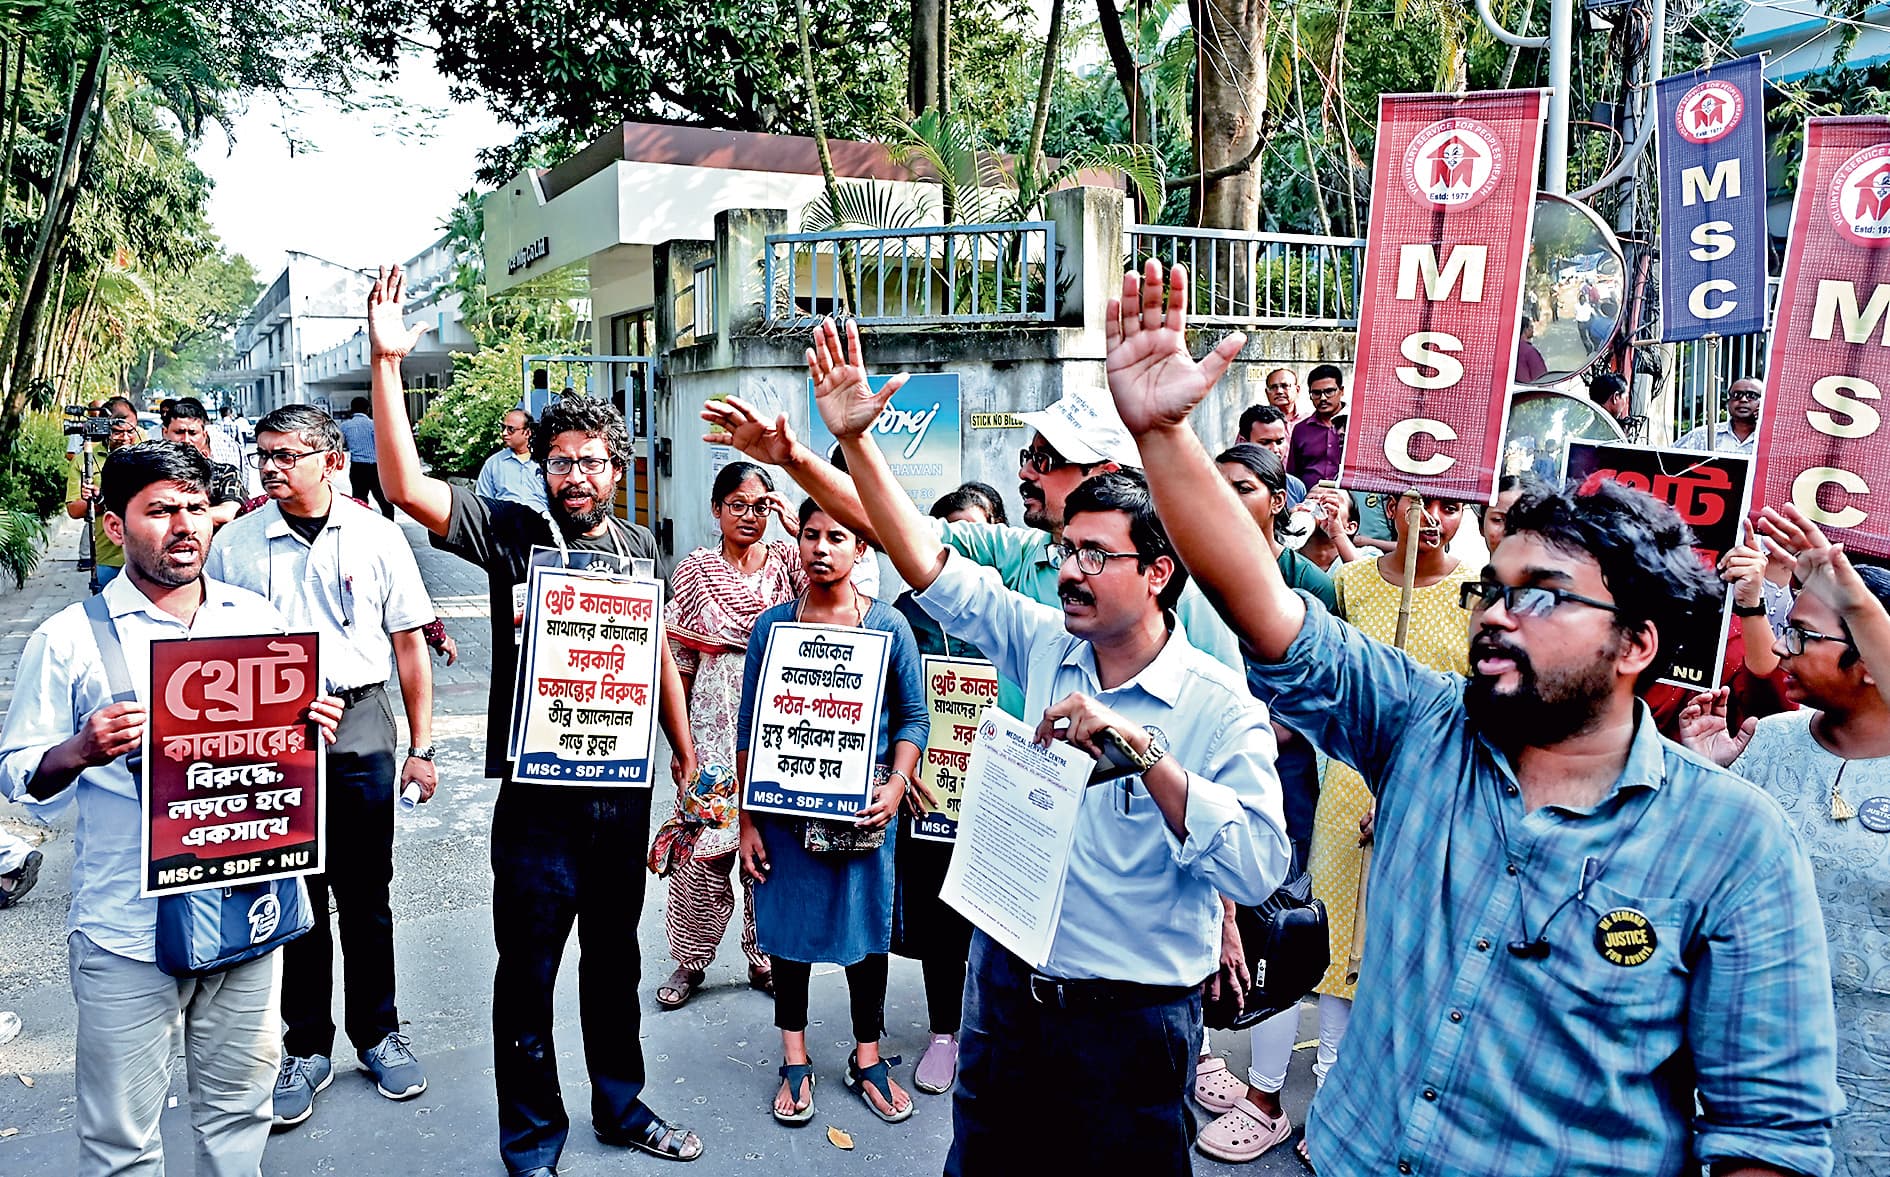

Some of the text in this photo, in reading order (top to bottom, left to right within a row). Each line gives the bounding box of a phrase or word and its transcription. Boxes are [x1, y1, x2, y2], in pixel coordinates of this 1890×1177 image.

[1405, 145, 1419, 195] VOLUNTARY
[1417, 123, 1452, 145] SERVICE
[1455, 121, 1474, 131] FOR
[1480, 163, 1502, 196] HEALTH
[1430, 192, 1469, 200] Estd: 1977
[1831, 148, 1886, 226] VOLUNTARY SERVICE
[1855, 225, 1876, 234] Estd:
[972, 415, 991, 426] STICK
[993, 414, 1002, 426] NO
[889, 463, 943, 476] HAWAN
[545, 584, 575, 616] থ্রেট
[579, 593, 653, 622] কালচারের
[546, 616, 648, 645] মাথাদের বাঁচানোর
[568, 644, 626, 674] সরকারি
[799, 635, 855, 661] মেডিকেল
[164, 640, 309, 723] থ্রেট
[781, 664, 863, 690] কলেজগুলিতে
[931, 669, 956, 697] থ্রেট
[1672, 665, 1703, 682] NU
[538, 673, 648, 706] চক্রান্তের বিরুদ্ধে
[548, 699, 633, 727] তীব্র আন্দোলন
[773, 689, 863, 725] পঠন-পাঠনের
[934, 699, 976, 719] মাথাদের
[162, 724, 306, 763] কালচারের
[559, 732, 618, 757] গড়ে তুলুন
[761, 719, 865, 752] সুস্থ পরিবেশ রক্ষা
[1006, 730, 1026, 746] MEDICAL
[1028, 741, 1048, 757] SERVICE
[1048, 752, 1067, 767] CENTRE
[526, 762, 641, 779] MSC SDF NU
[778, 754, 842, 780] করতে হবে
[928, 748, 971, 773] চক্রান্তে
[186, 762, 285, 791] বিরুদ্ধে,
[936, 767, 958, 794] তীব্র
[168, 788, 303, 820] লড়তে হবে
[754, 790, 859, 813] MSC SDF NU
[181, 816, 290, 847] একসাথে
[921, 821, 951, 835] MSC
[158, 851, 309, 886] MSC SDF NU
[1598, 911, 1646, 931] WE DEMAND
[1605, 929, 1649, 947] JUSTICE
[1605, 949, 1622, 963] FOR
